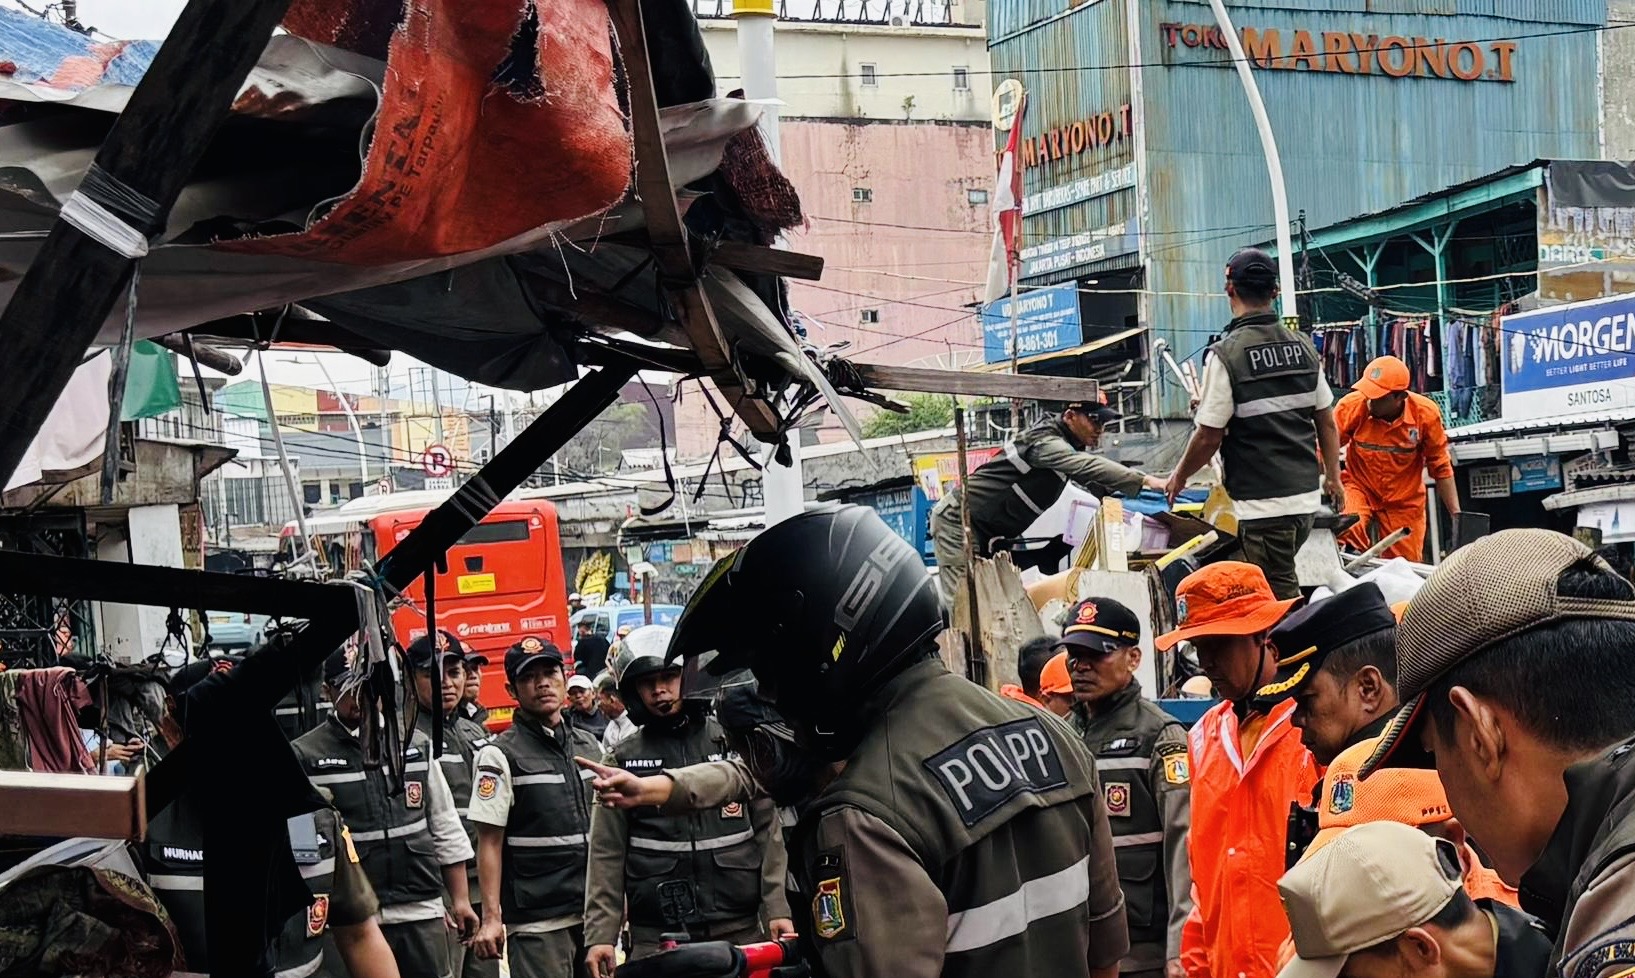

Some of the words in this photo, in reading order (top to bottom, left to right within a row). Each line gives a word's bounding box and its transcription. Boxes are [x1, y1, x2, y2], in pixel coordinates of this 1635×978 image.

[1250, 348, 1283, 371] POL
[1546, 365, 1567, 377] BETTER
[1569, 363, 1588, 374] LIGHT
[1589, 361, 1612, 371] BETTER
[1613, 357, 1627, 367] LIFE
[1568, 388, 1611, 407] SANTOSA
